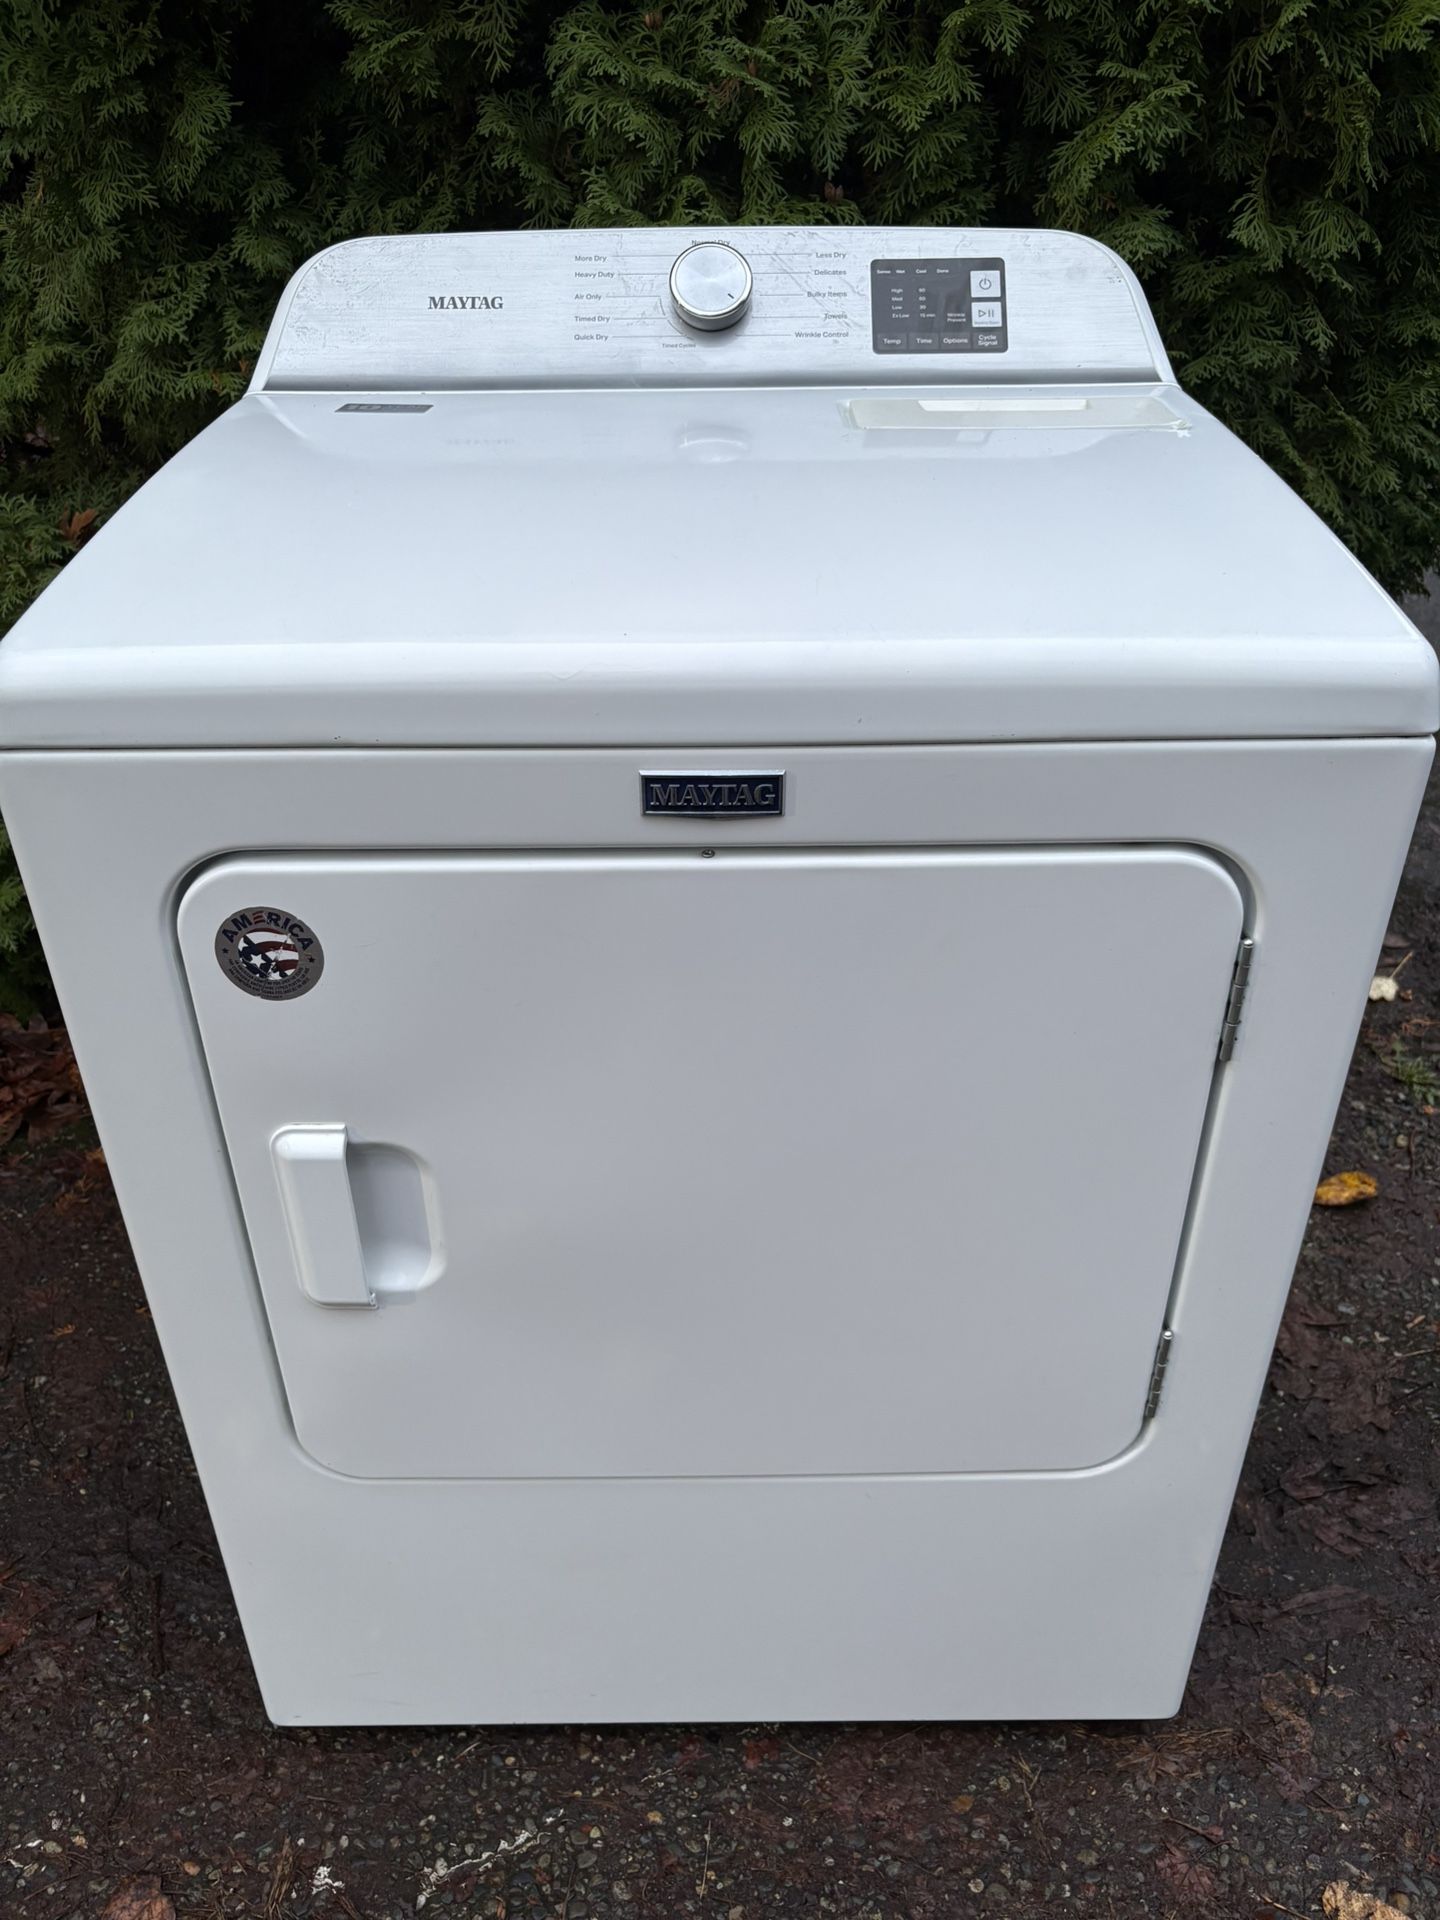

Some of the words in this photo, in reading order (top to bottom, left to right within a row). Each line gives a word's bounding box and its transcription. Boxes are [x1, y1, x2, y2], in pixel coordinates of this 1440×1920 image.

[833, 252, 847, 260] Dry
[574, 271, 597, 279] Heavy
[597, 271, 615, 279] Duty
[807, 291, 826, 299] Bulky
[427, 296, 504, 310] MAYTAG
[595, 334, 609, 342] Dry
[883, 338, 902, 346] Temp
[943, 338, 969, 346] Options
[650, 783, 776, 807] MAYTAG
[222, 910, 314, 951] AMERICA
